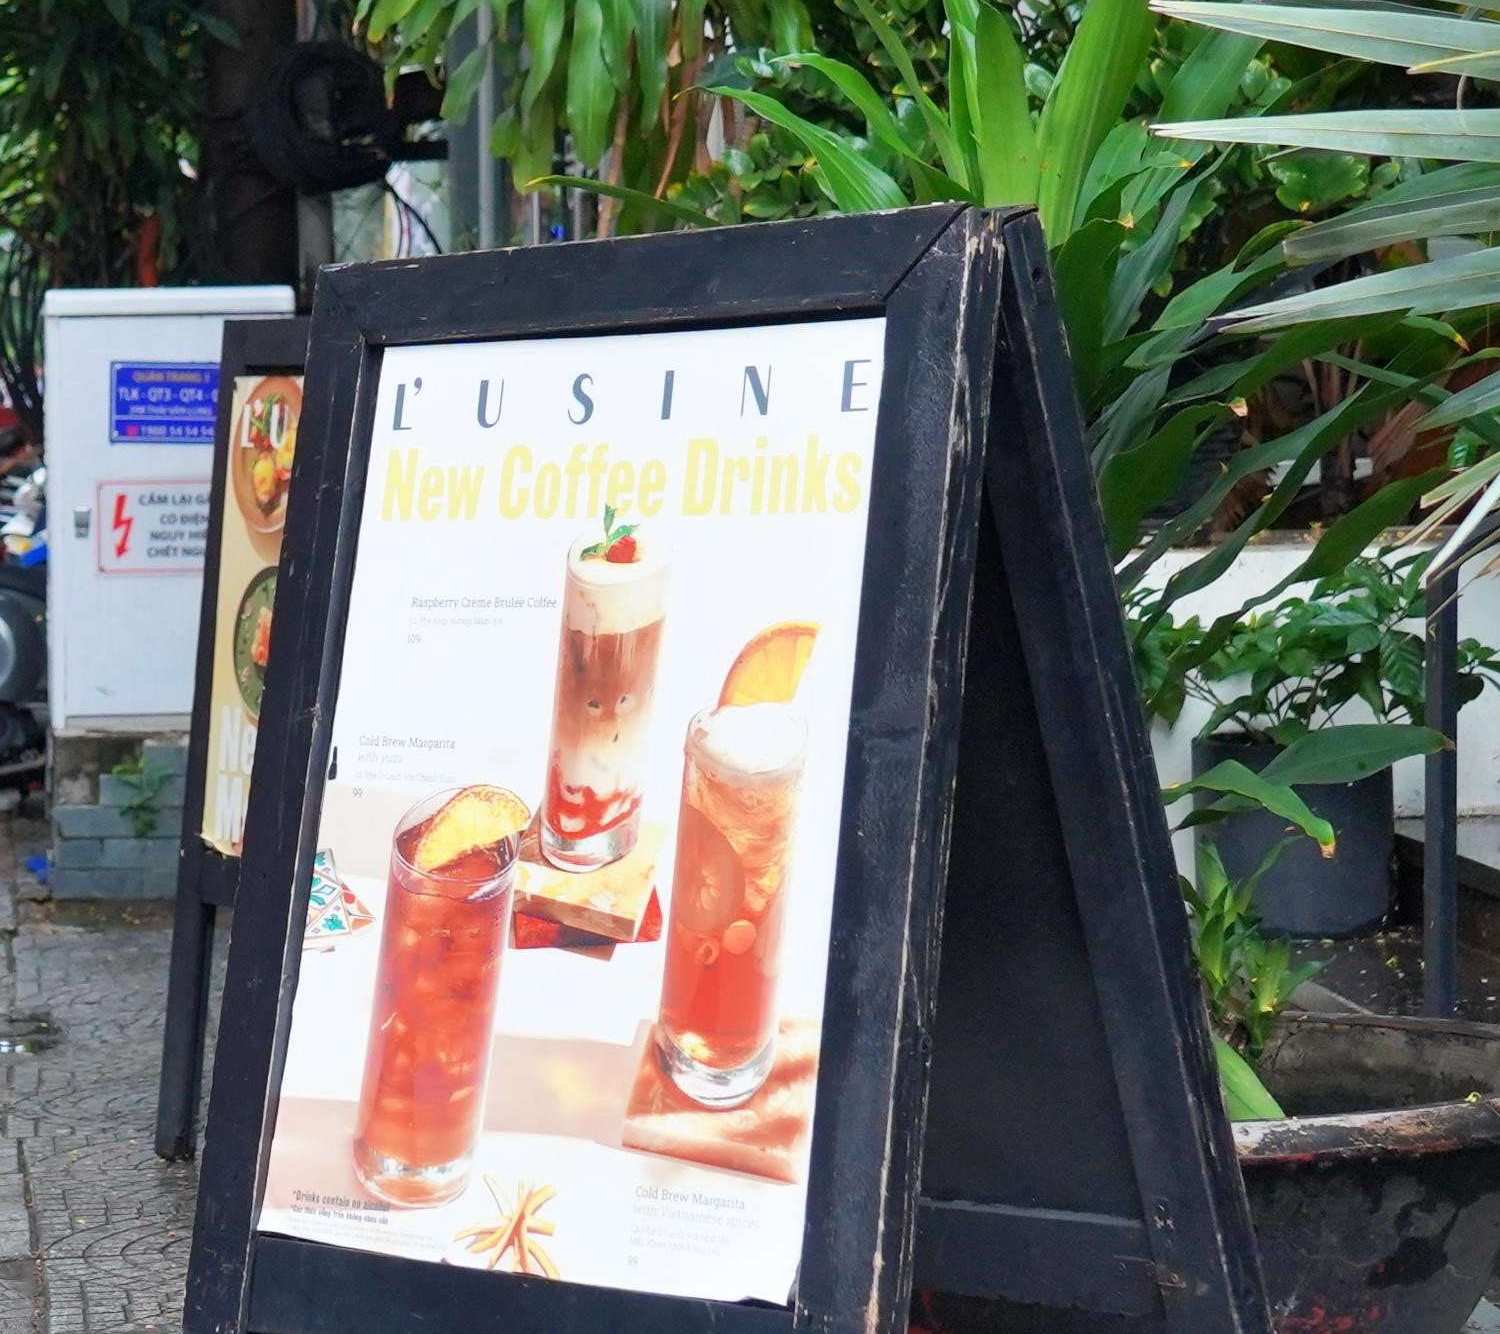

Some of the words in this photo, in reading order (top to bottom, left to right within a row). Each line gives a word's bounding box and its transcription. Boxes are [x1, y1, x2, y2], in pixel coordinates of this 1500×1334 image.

[391, 358, 873, 432] L'USINE
[380, 447, 485, 522] New
[498, 440, 665, 520] Coffee
[680, 433, 863, 518] Drinks
[411, 596, 460, 610] Raspberry
[527, 596, 558, 608] Coffee
[359, 734, 379, 747] Cold
[381, 735, 406, 748] Brew
[408, 736, 456, 751] Margarita
[358, 751, 379, 763] with
[352, 787, 364, 798] 99
[217, 772, 246, 843] M
[322, 1195, 350, 1208] contain
[352, 1200, 361, 1209] no
[635, 1185, 659, 1200] Cold
[661, 1188, 689, 1203] Brew
[692, 1192, 746, 1211] Margarita
[633, 1203, 657, 1217] with
[660, 1206, 724, 1227] Vietnamese
[626, 1254, 639, 1267] 99
